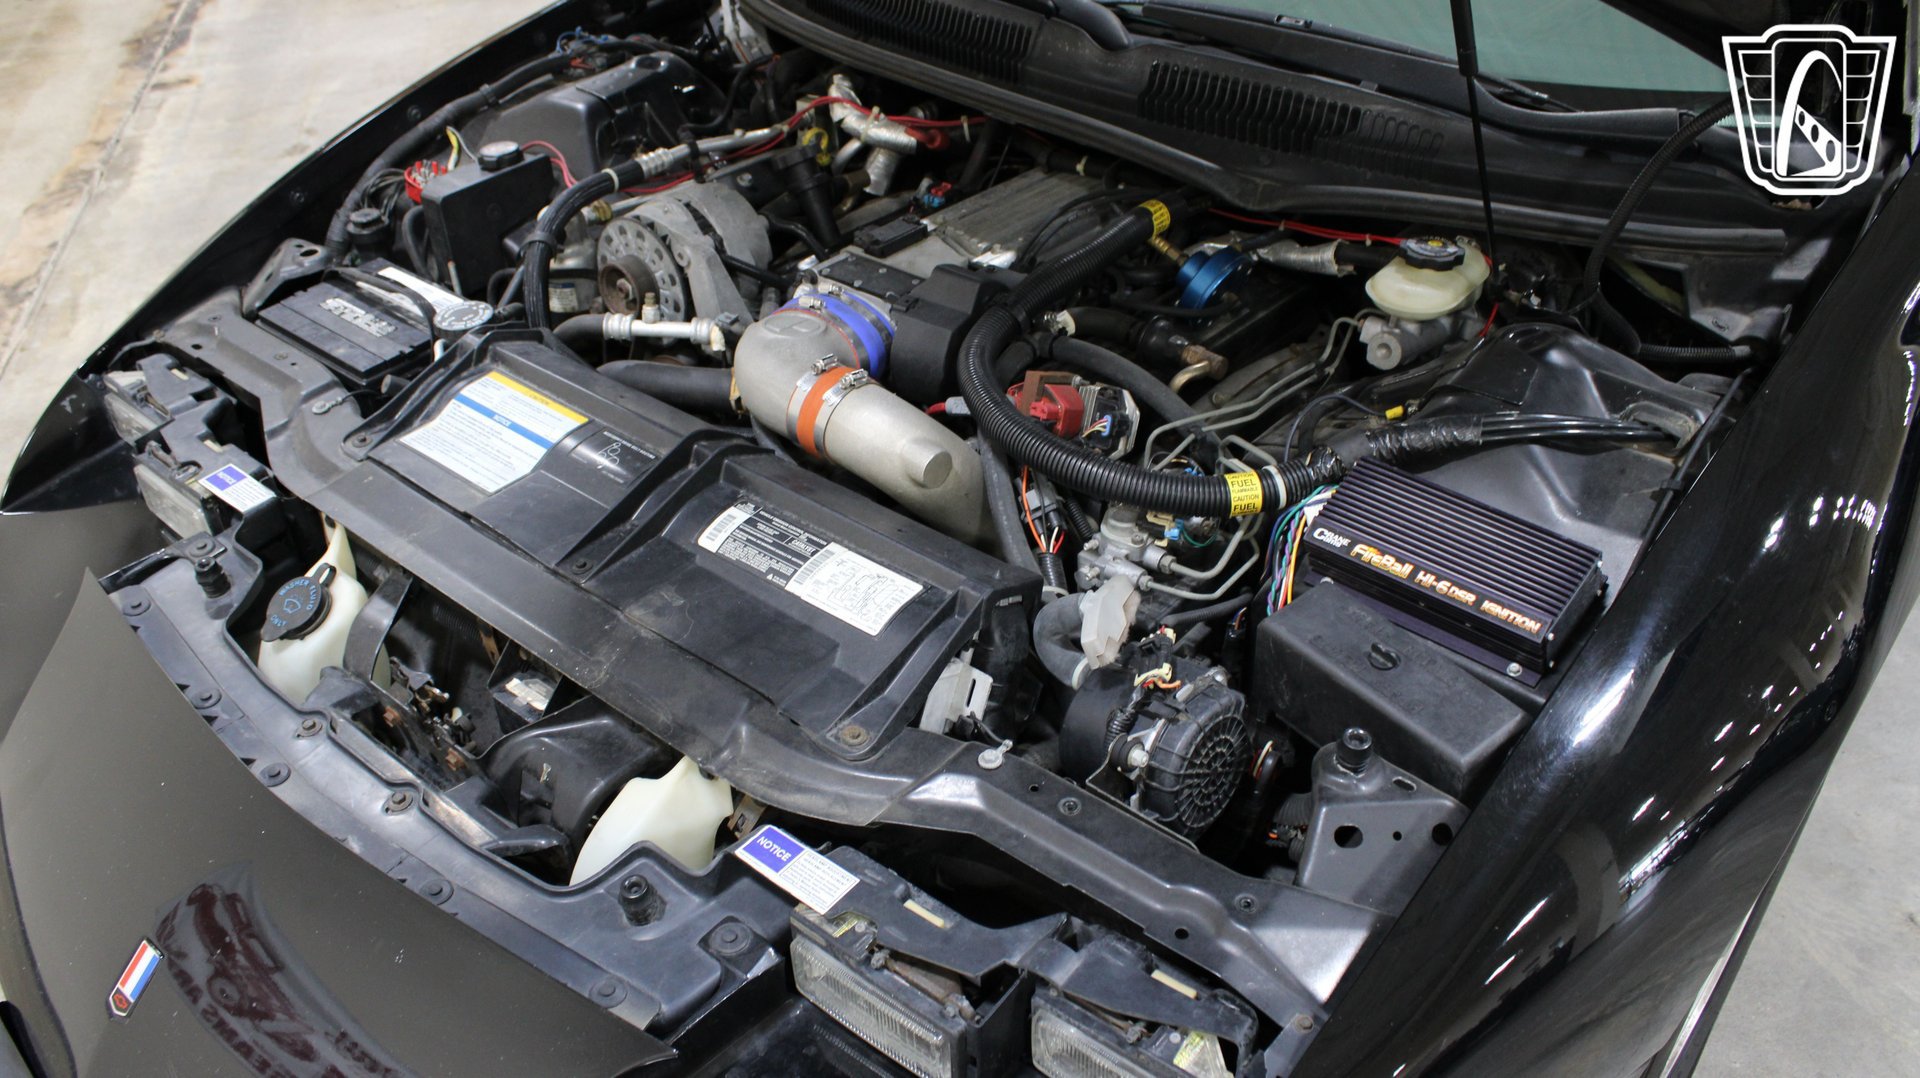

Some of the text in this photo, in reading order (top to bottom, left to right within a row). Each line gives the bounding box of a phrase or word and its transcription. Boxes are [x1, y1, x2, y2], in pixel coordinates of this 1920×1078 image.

[1231, 479, 1257, 488] FUEL
[1233, 494, 1260, 502] CAUTION
[1233, 503, 1257, 512] FUEL
[279, 579, 316, 610] WASHER FLUID
[271, 614, 288, 627] ONLY
[1479, 600, 1542, 634] IGNITION
[756, 836, 792, 862] NOTICE
